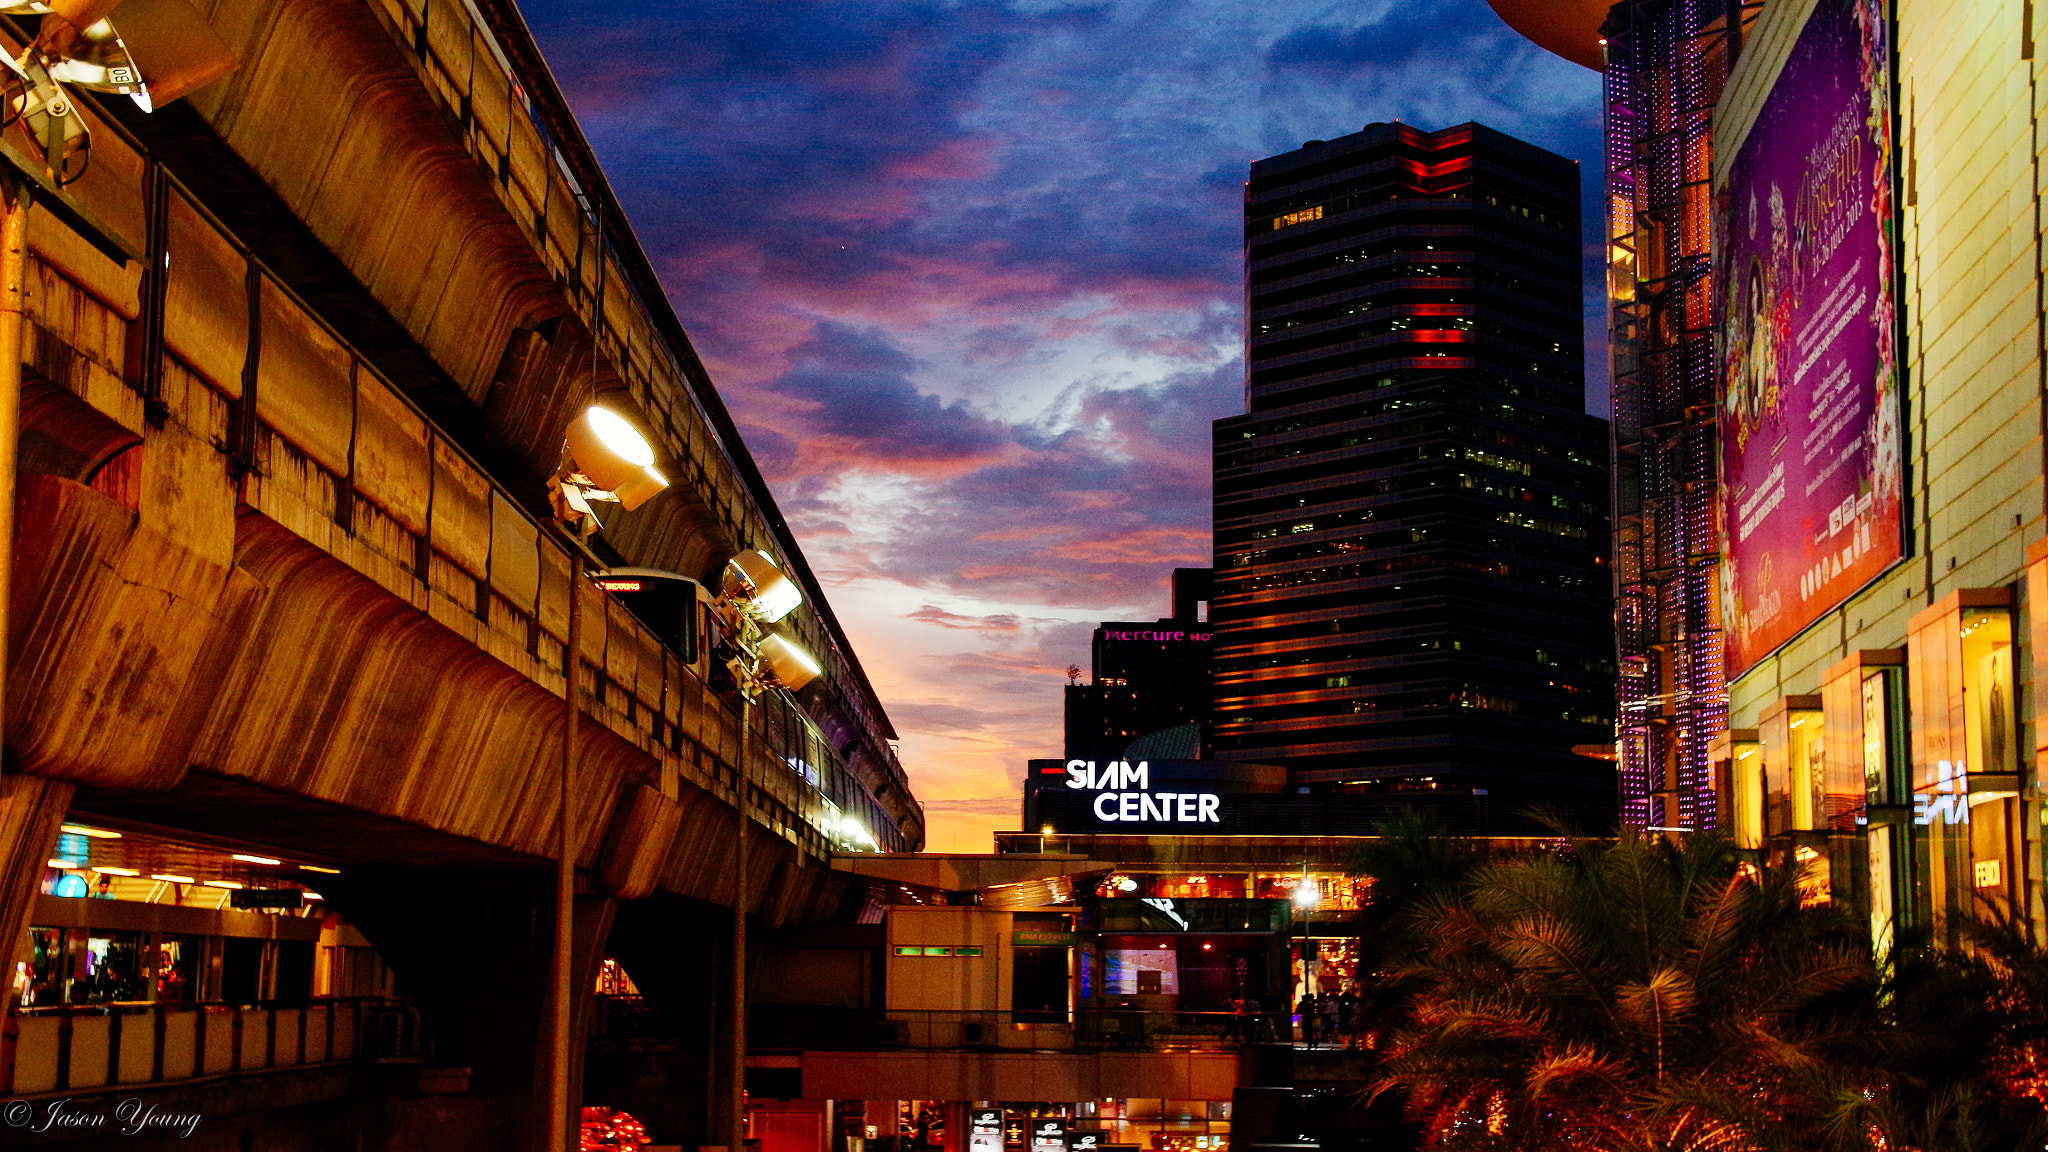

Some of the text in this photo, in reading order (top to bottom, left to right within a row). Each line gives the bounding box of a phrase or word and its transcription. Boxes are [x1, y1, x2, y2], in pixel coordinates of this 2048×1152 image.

[1811, 134, 1861, 232] ORCHID
[1845, 193, 1863, 233] 2015
[1065, 759, 1149, 790] SIAM
[1093, 792, 1220, 822] CENTER
